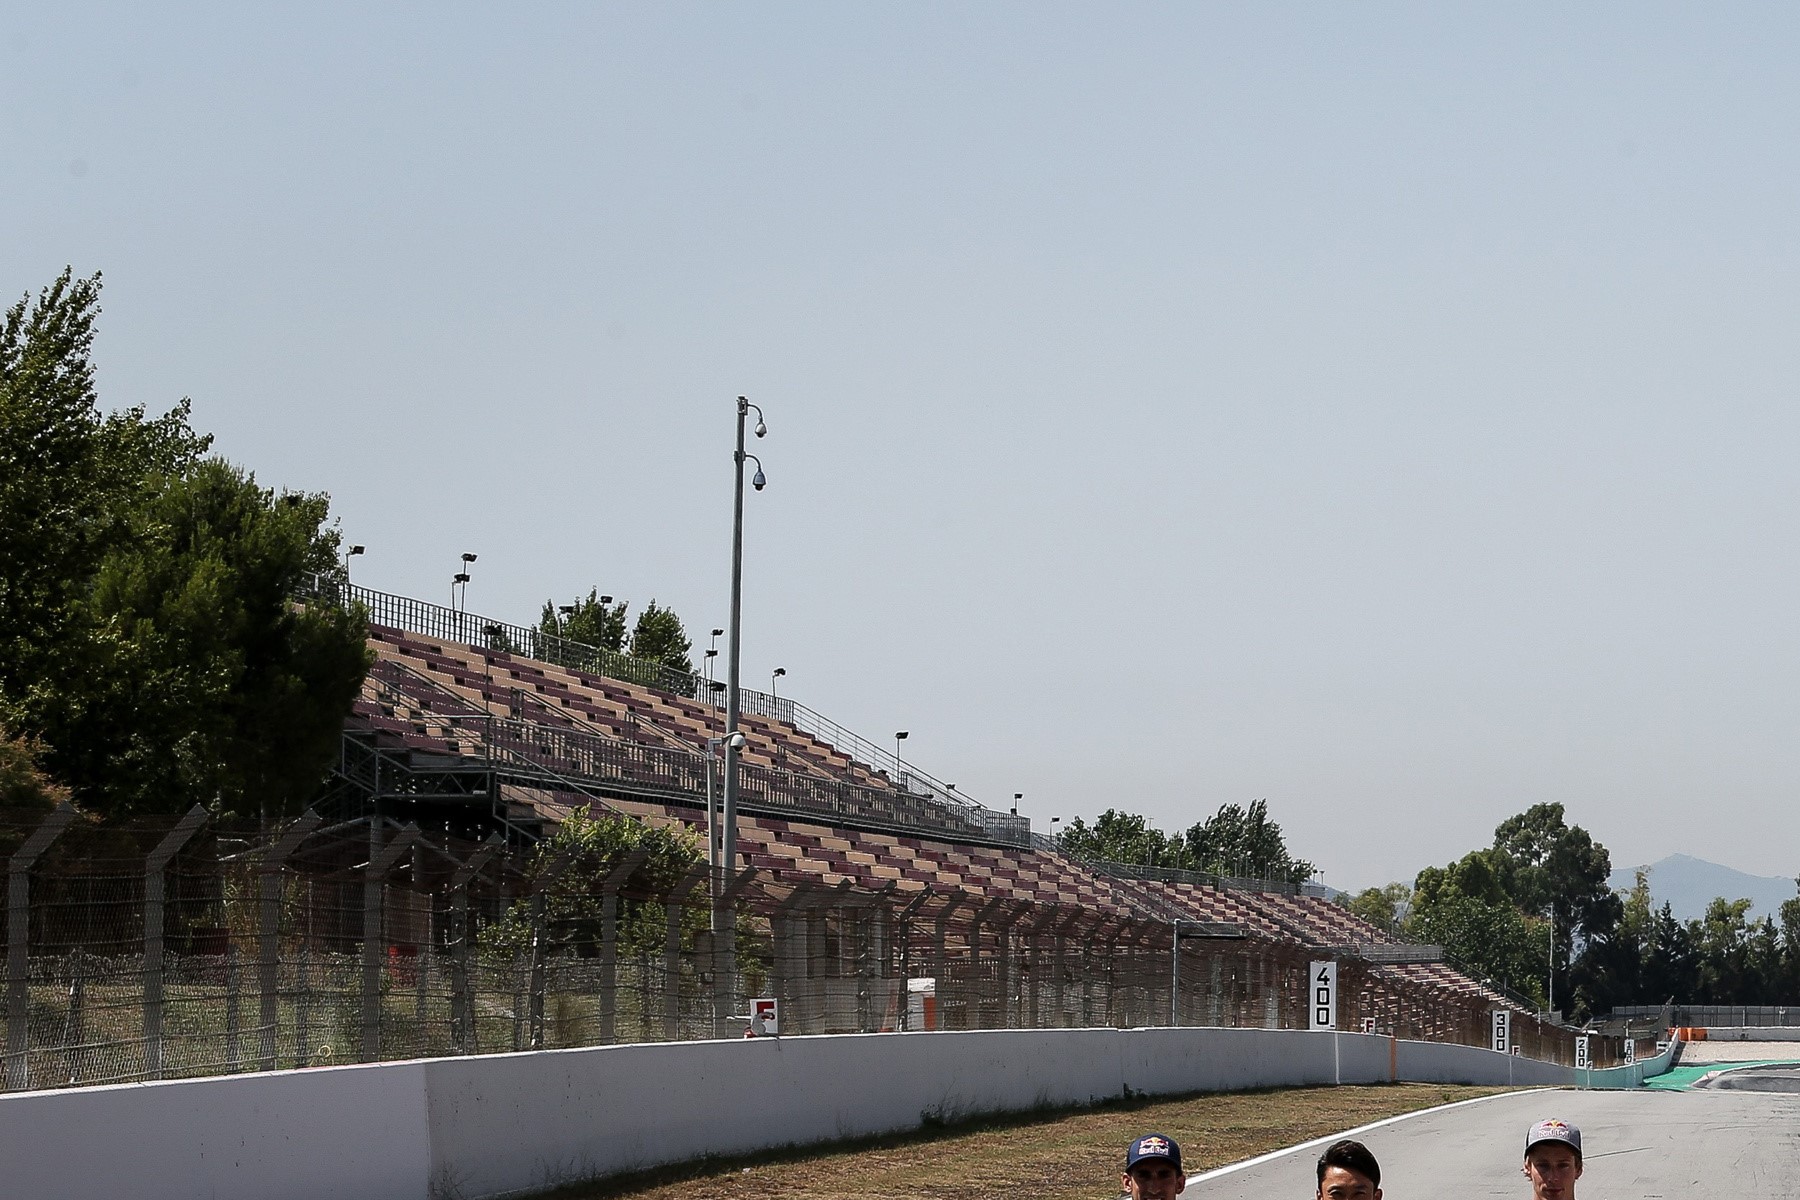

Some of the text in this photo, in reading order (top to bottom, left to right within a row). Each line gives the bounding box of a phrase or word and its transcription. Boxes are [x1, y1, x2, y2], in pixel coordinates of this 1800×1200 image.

[1317, 967, 1330, 1025] 400
[1366, 1020, 1373, 1032] F
[1497, 1013, 1505, 1051] 300
